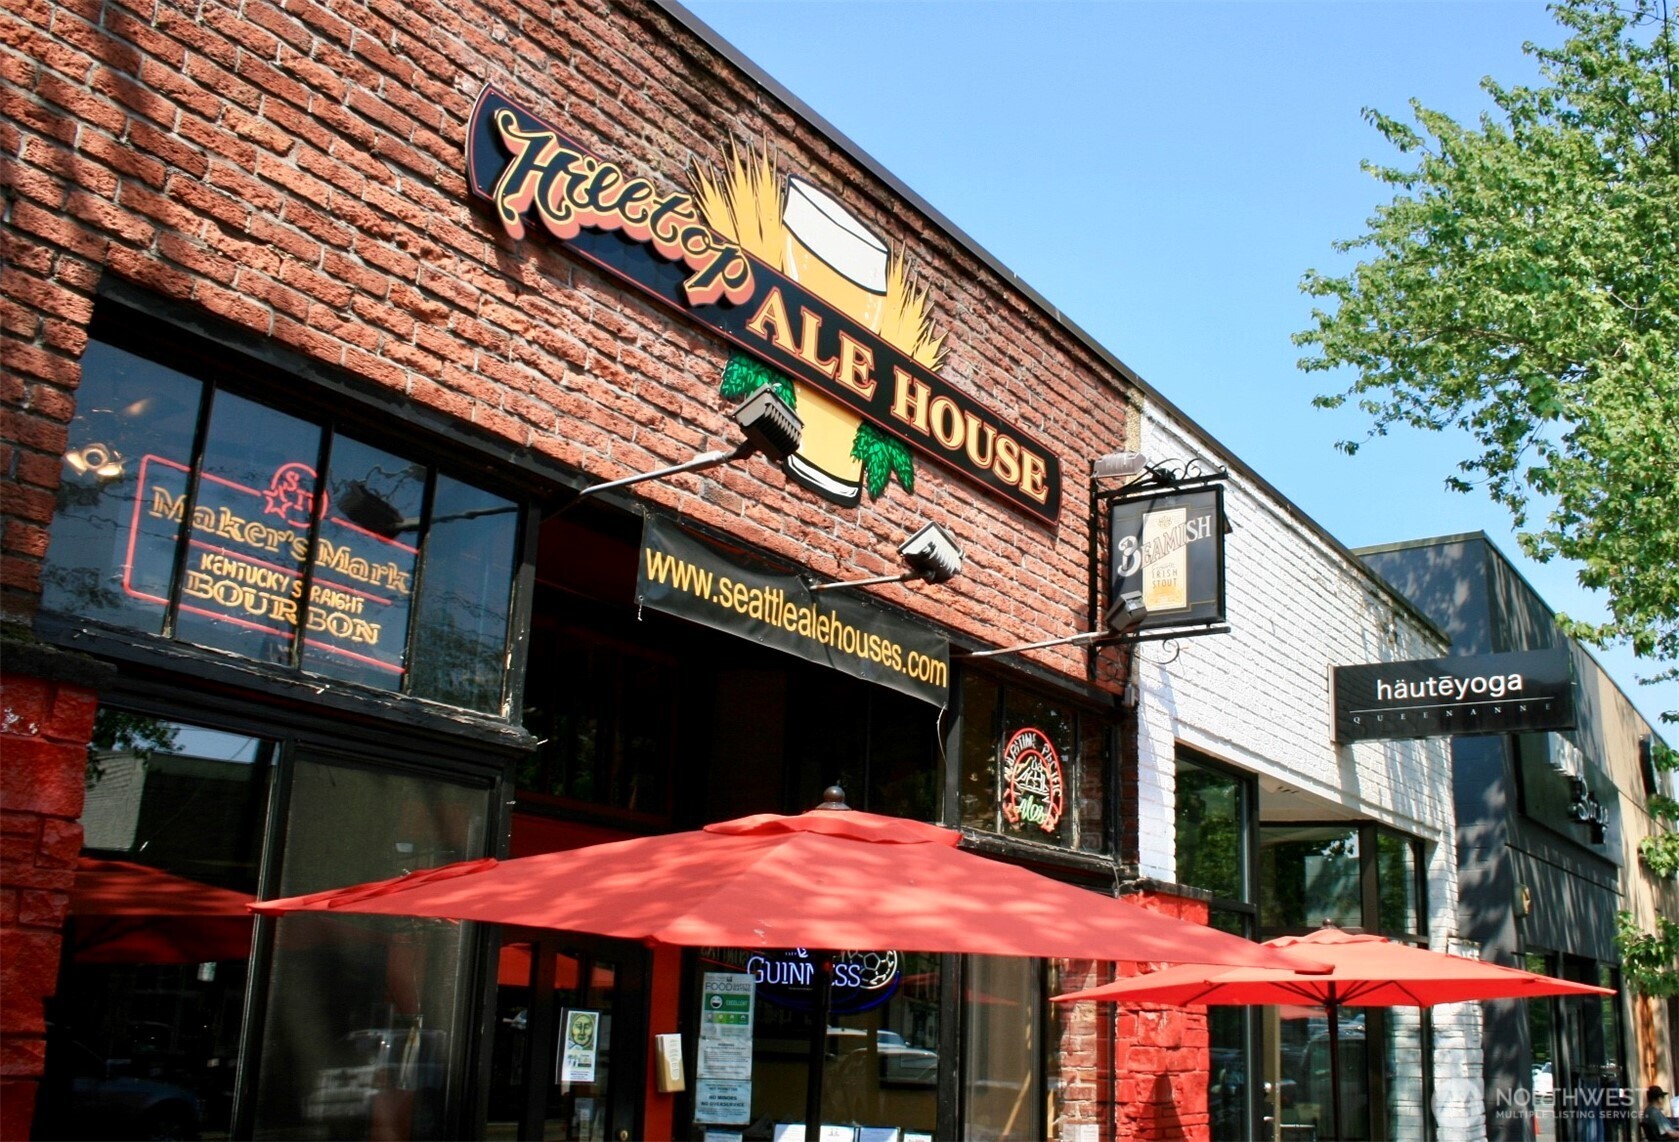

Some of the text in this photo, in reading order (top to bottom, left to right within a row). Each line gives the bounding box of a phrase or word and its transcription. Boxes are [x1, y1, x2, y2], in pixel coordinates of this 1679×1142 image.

[495, 109, 755, 304] Hilltop
[746, 287, 1049, 505] ALE HOUSE
[149, 486, 410, 594] Maker's Mark
[1117, 515, 1211, 577] BEAMISH
[201, 553, 365, 615] KENTUCKY SRAIGHT
[1152, 568, 1178, 579] IRISH
[1152, 578, 1177, 589] STOUT
[183, 570, 381, 646] BOURBON
[646, 548, 947, 688] www.seattlealehouses.com
[1377, 674, 1523, 701] häutēyoga
[705, 982, 733, 991] FOOD
[747, 956, 861, 988] GUINNSS
